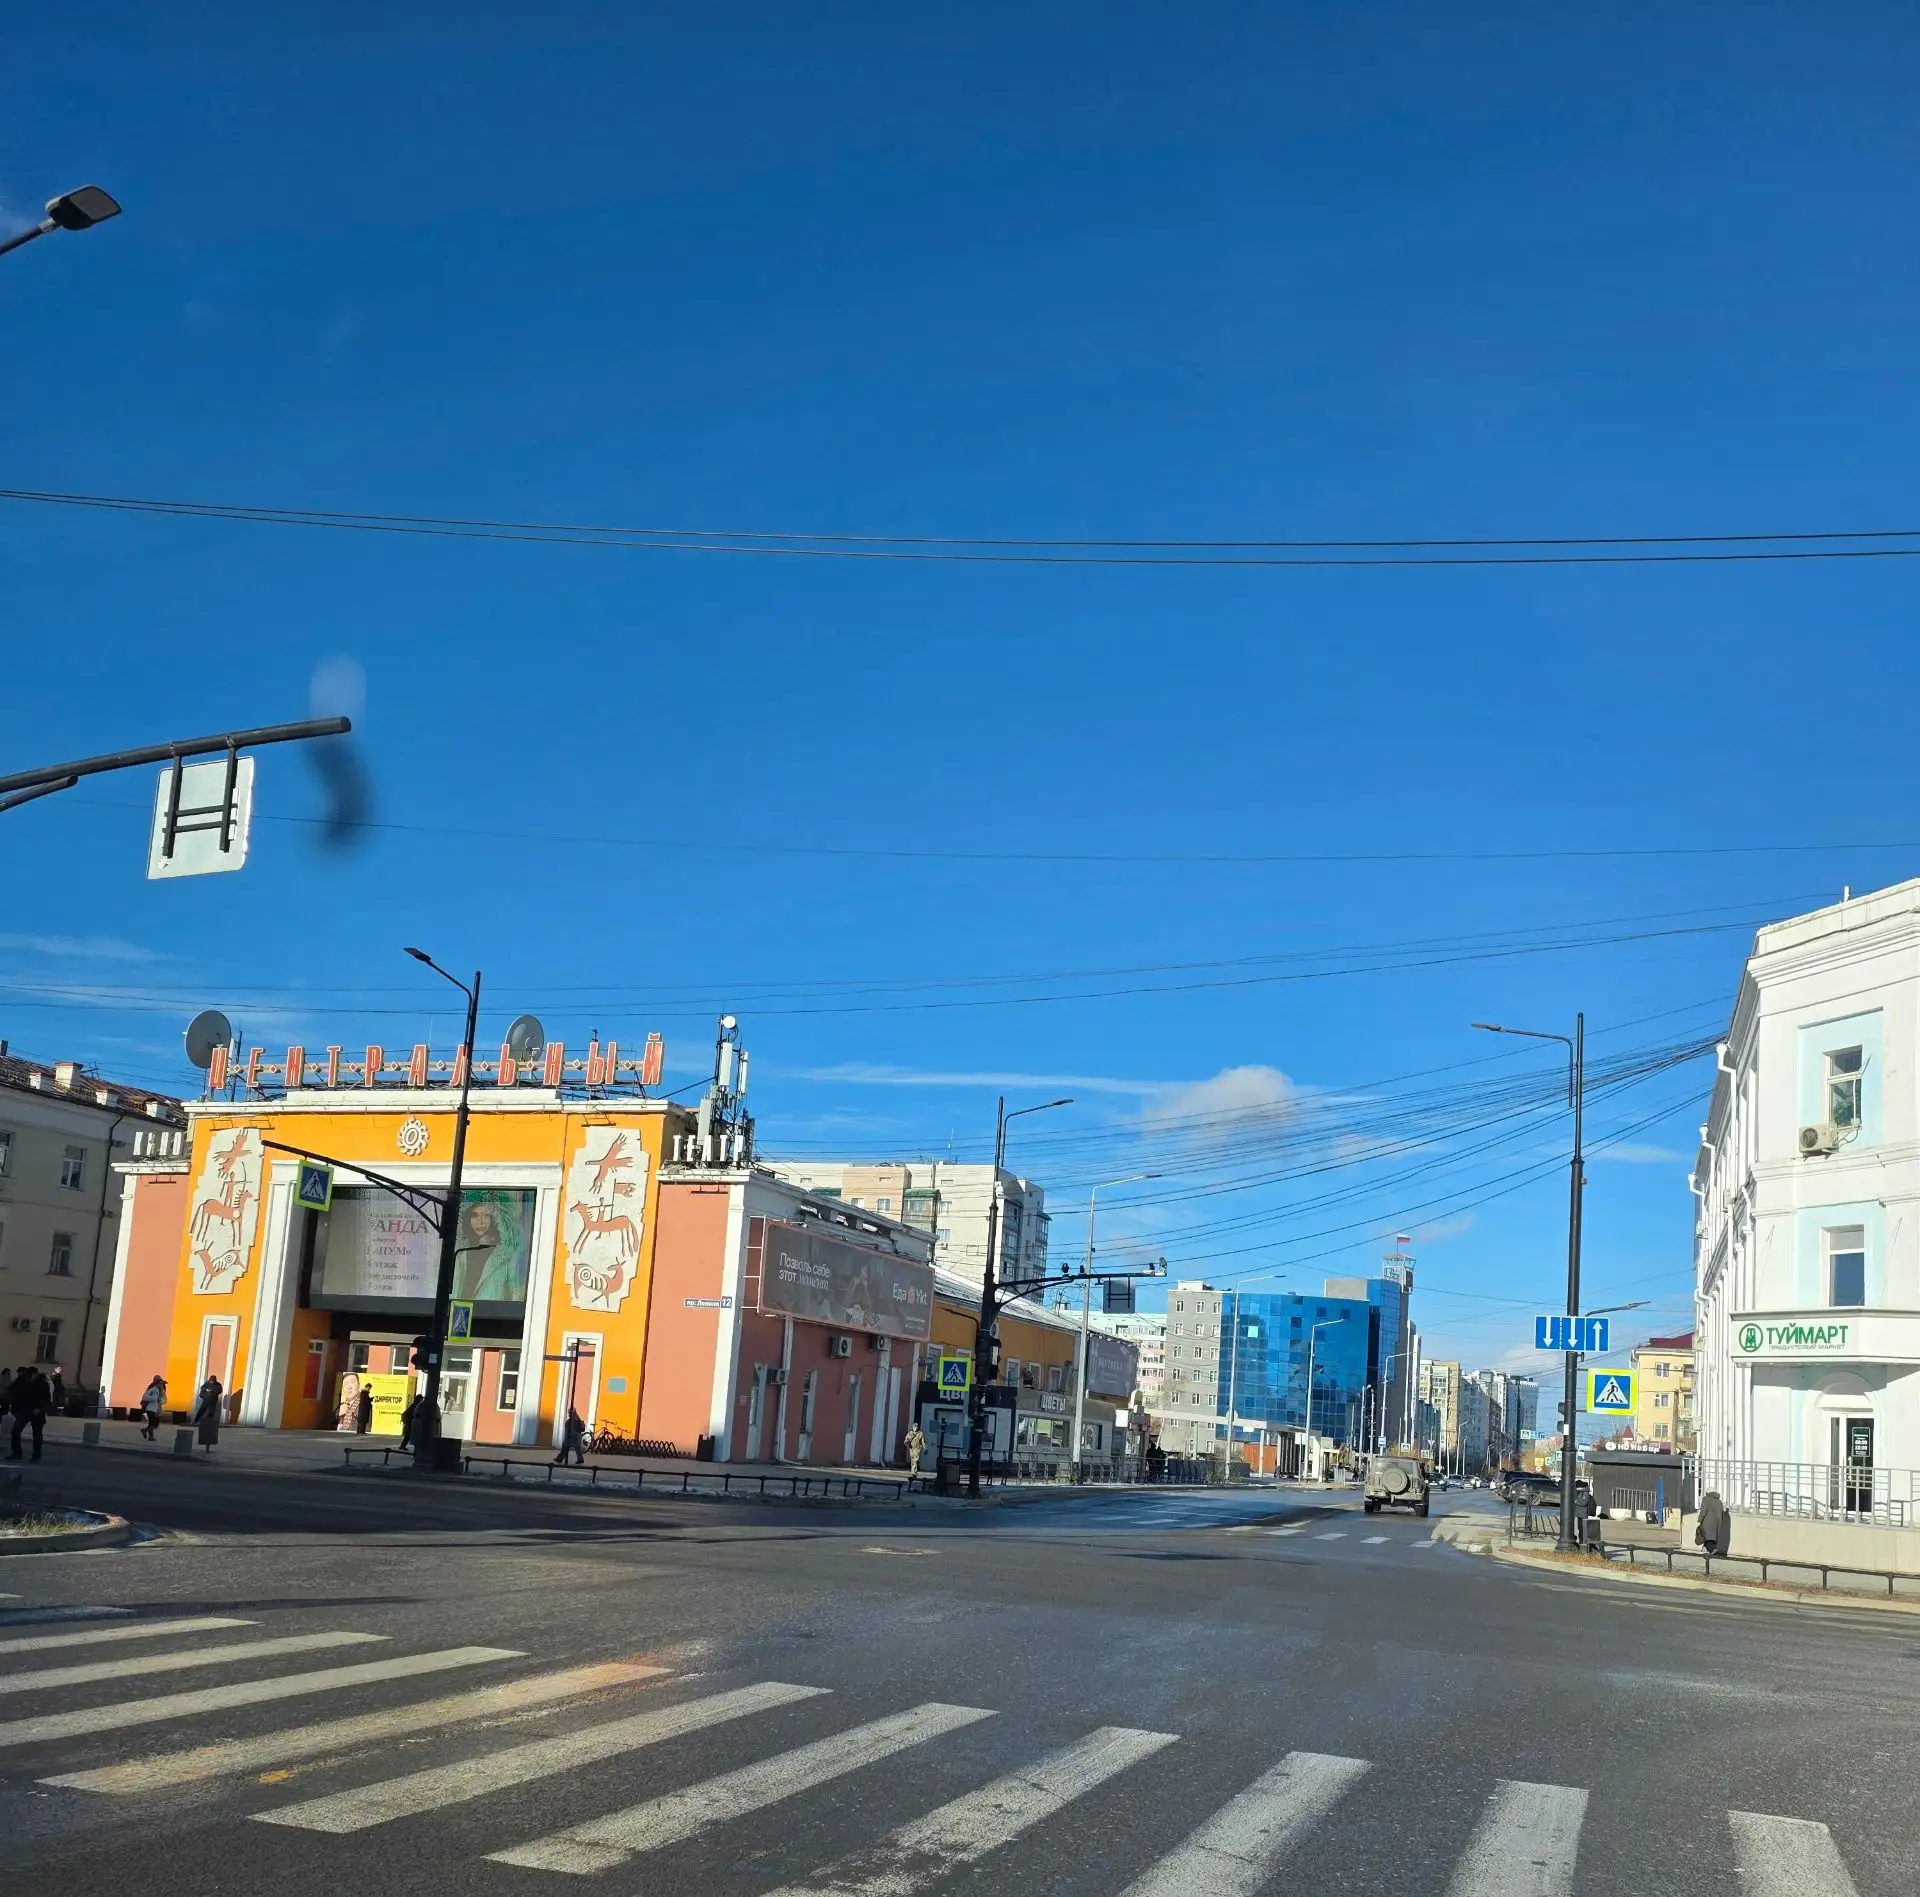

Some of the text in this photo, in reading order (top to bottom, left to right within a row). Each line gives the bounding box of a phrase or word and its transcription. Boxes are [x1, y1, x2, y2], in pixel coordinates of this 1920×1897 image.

[209, 1032, 664, 1089] ЦЕНТРАЛЬНЫЙ
[673, 1134, 744, 1162] ТЕАТР
[779, 1252, 812, 1273] Позволь
[778, 1269, 797, 1283] этот
[722, 1297, 732, 1307] 12
[892, 1283, 907, 1302] Еда
[1766, 1322, 1849, 1345] ТУЙМАРТ
[1041, 1394, 1066, 1411] ЦВЕТЫ
